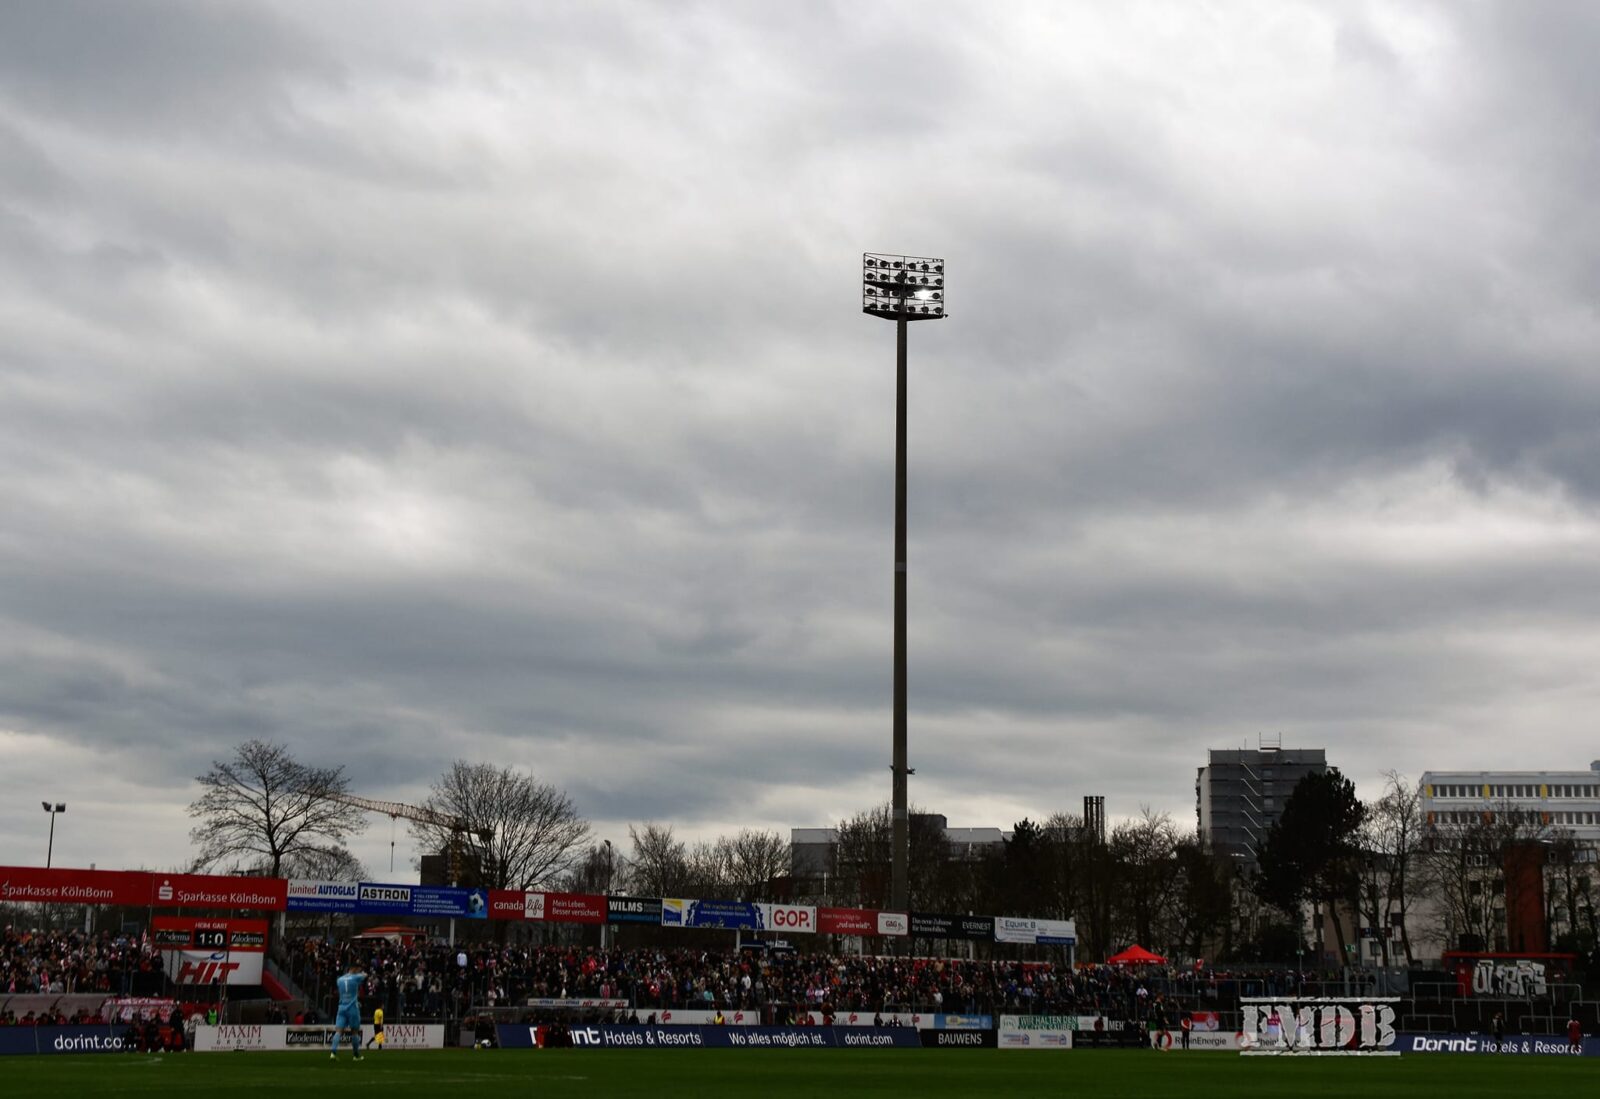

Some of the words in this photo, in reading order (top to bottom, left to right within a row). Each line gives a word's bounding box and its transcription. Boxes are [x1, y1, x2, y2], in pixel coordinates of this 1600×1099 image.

[2, 881, 58, 897] Sparkasse
[61, 885, 114, 898] KölnBonn
[289, 883, 317, 895] junited
[318, 885, 356, 896] AUTOGLAS
[362, 889, 409, 900] ASTRON
[178, 890, 227, 903] Sparkasse
[230, 891, 277, 905] KölnBonn
[552, 899, 567, 907] Mein
[494, 900, 524, 911] canada
[526, 899, 543, 916] life
[552, 907, 570, 915] Besser
[608, 901, 643, 913] WILMS
[774, 910, 810, 927] GOP.
[962, 921, 991, 931] EVERNEST
[199, 932, 224, 946] 1:0
[176, 962, 240, 984] HIT
[218, 1025, 262, 1038] MAXIM
[386, 1025, 425, 1038] MAXIM
[604, 1030, 643, 1046] Hotels
[645, 1031, 655, 1045] &
[657, 1030, 702, 1046] Resorts
[54, 1033, 137, 1049] dorint.co
[728, 1032, 746, 1045] Wo
[747, 1032, 771, 1045] alles
[772, 1032, 810, 1047] möglich
[811, 1032, 826, 1045] ist.
[844, 1032, 893, 1046] dorint.com
[938, 1033, 982, 1045] BAUWENS
[1412, 1036, 1478, 1052] Dorint
[1521, 1041, 1530, 1054] &
